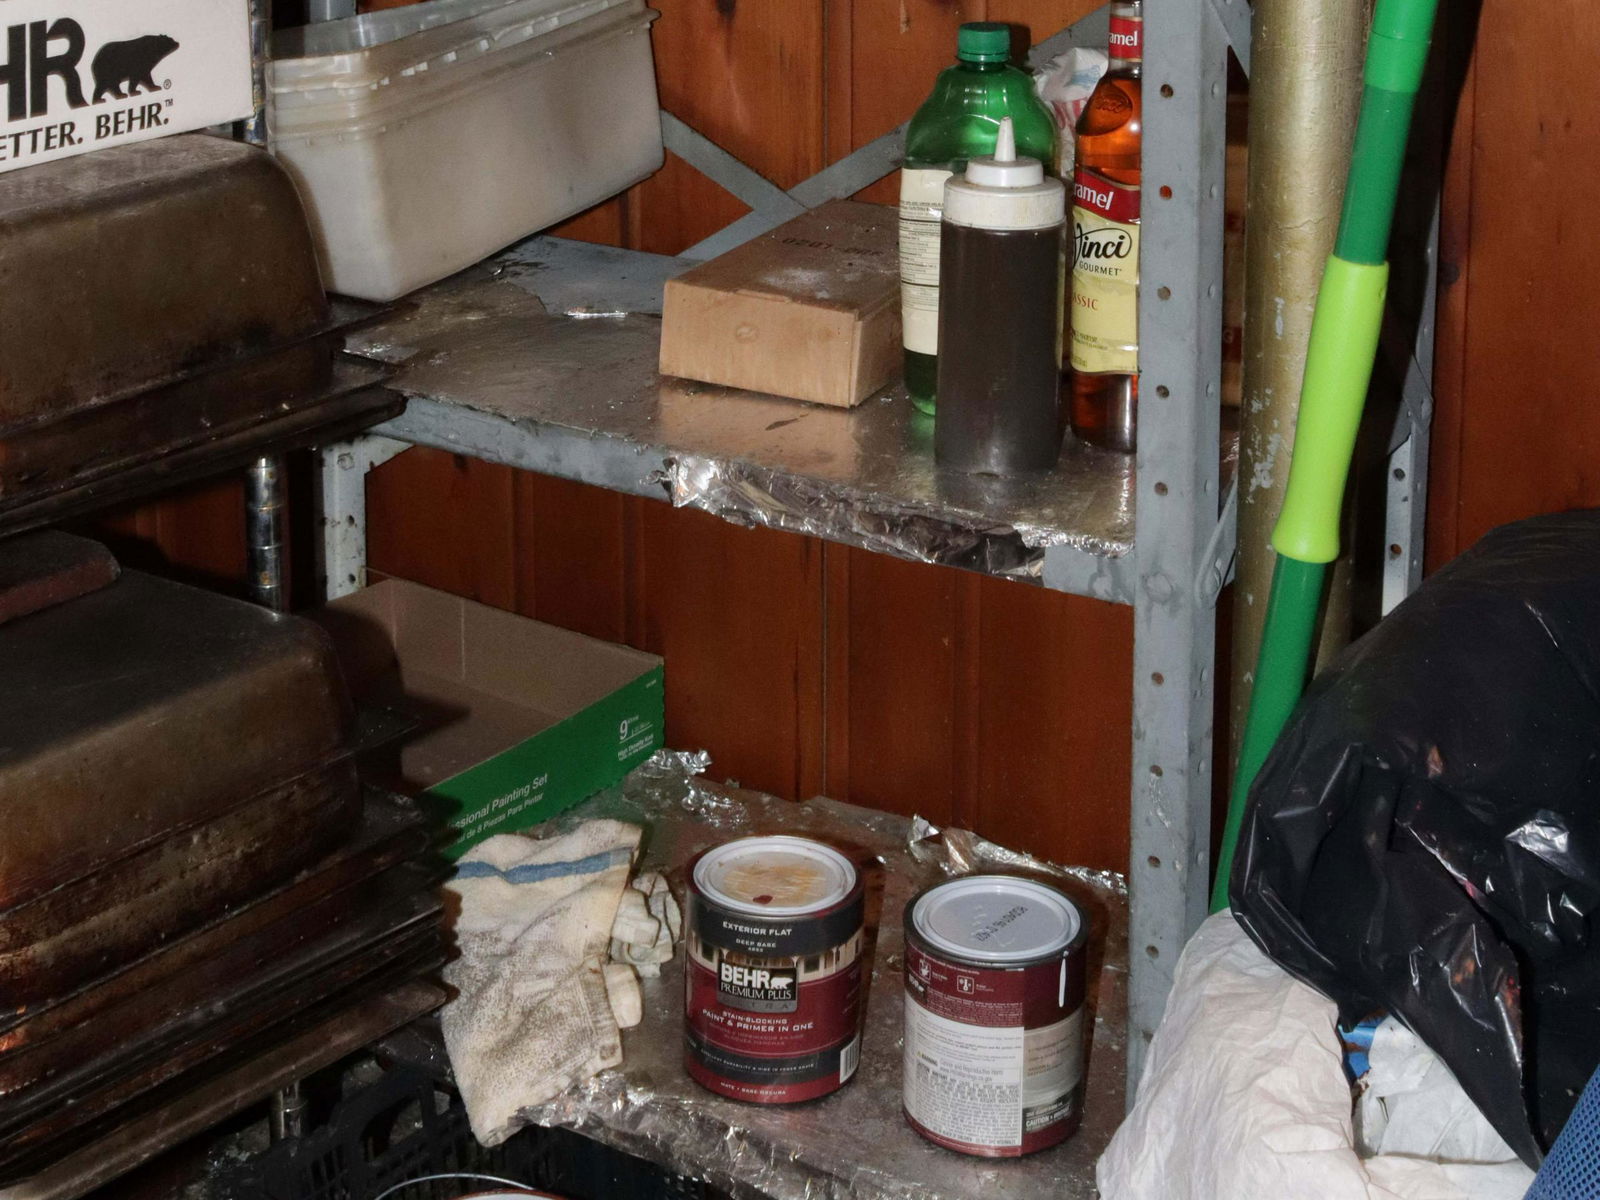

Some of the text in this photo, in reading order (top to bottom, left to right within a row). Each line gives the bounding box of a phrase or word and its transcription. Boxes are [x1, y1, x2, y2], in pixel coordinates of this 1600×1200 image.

[95, 102, 169, 141] BEHR.
[1079, 261, 1120, 276] GOURMET
[620, 720, 628, 740] 9
[492, 784, 530, 812] Painting
[532, 773, 548, 790] Set
[723, 921, 792, 936] EXTERIOR FLAT
[736, 938, 755, 947] DEEP
[720, 962, 770, 989] BEHR
[720, 982, 792, 1000] PREMIUM PLUS
[702, 1009, 724, 1023] PAINT
[736, 1022, 775, 1032] PRIMER
[793, 1022, 814, 1032] ONE
[722, 1011, 788, 1024] STAIN-BLOCKING
